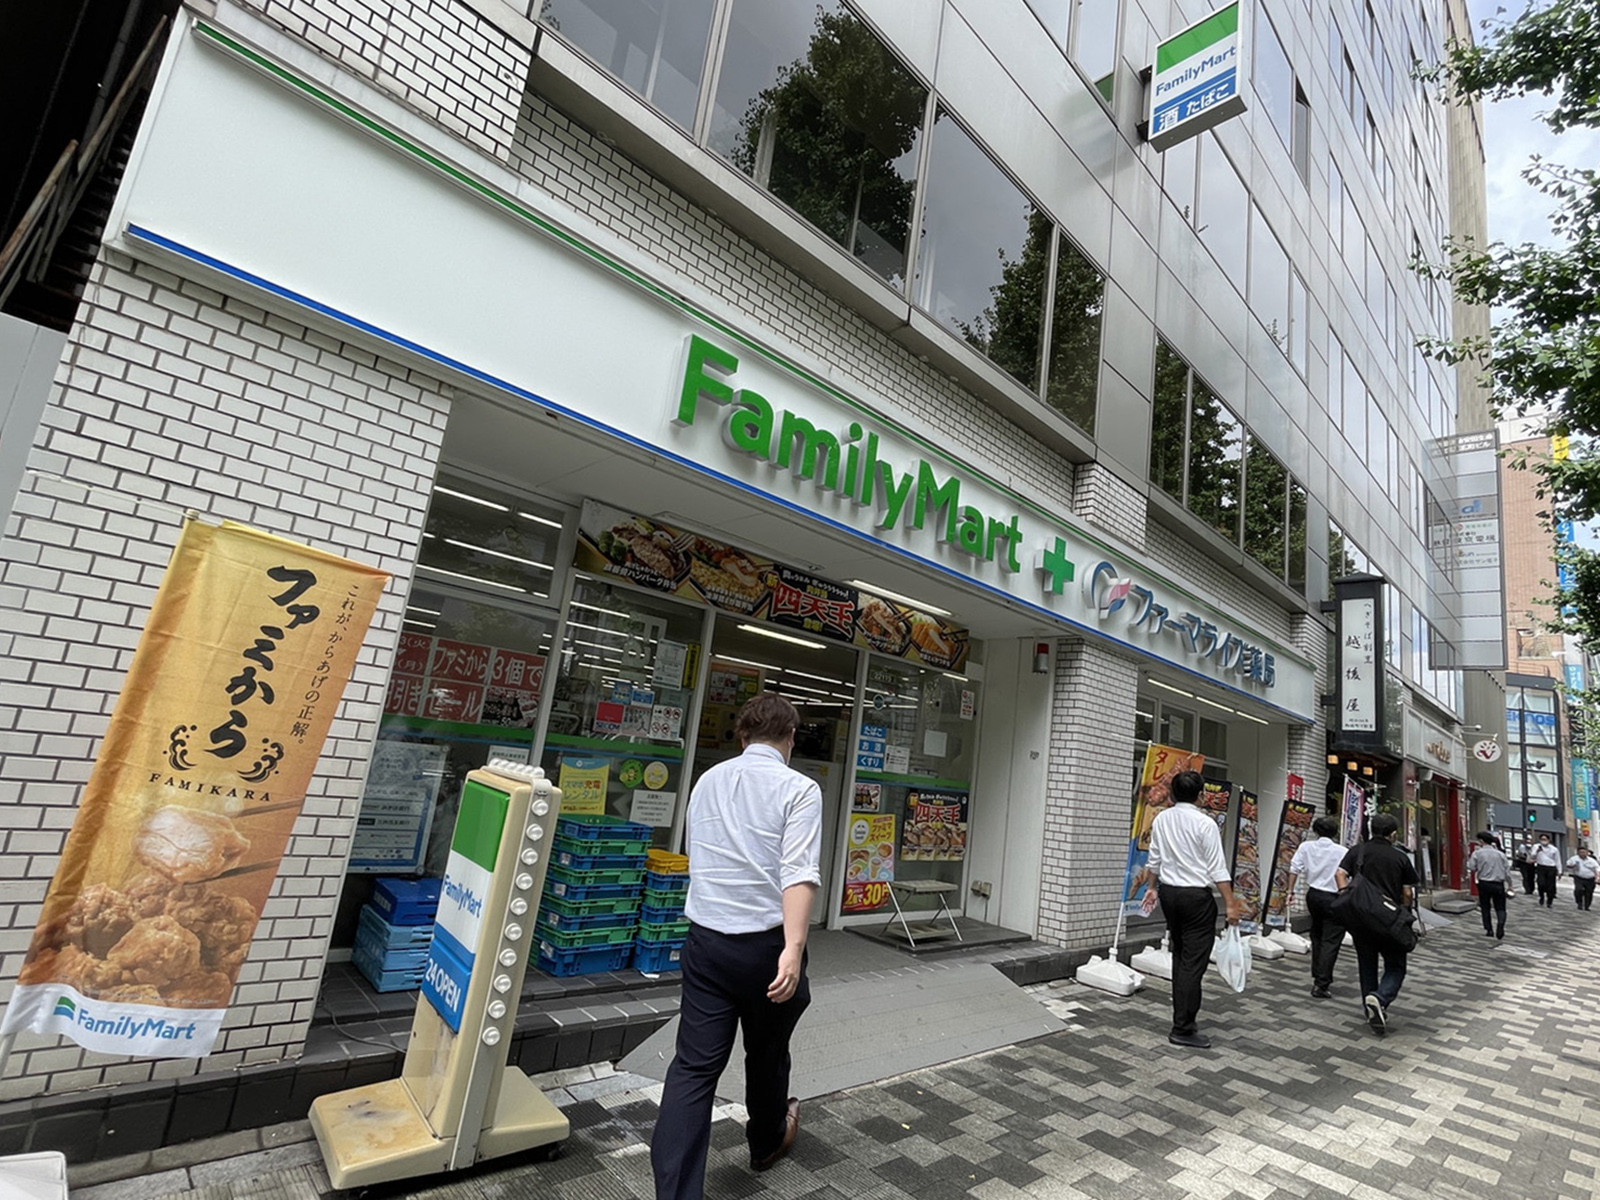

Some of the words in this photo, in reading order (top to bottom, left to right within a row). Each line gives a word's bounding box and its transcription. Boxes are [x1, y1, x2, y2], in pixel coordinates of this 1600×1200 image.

[1156, 45, 1237, 97] FamilyMart
[1158, 105, 1180, 132] 酒
[1186, 83, 1231, 117] たばこ
[672, 333, 1023, 575] FamilyMart
[771, 581, 854, 638] 四天王
[1131, 585, 1276, 688] ファーマライフ薬局
[203, 563, 321, 760] ファミから
[289, 583, 360, 745] これが、からあげの正解。
[432, 646, 489, 680] ファミから
[492, 655, 543, 688] 3個で
[1345, 635, 1361, 712] 越後屋
[863, 726, 883, 738] たばこ
[860, 757, 880, 767] くすり
[149, 772, 272, 802] FAMIKARA
[914, 802, 961, 827] 四天王
[441, 874, 482, 918] FamilyMart
[77, 1008, 196, 1040] FamilyMart
